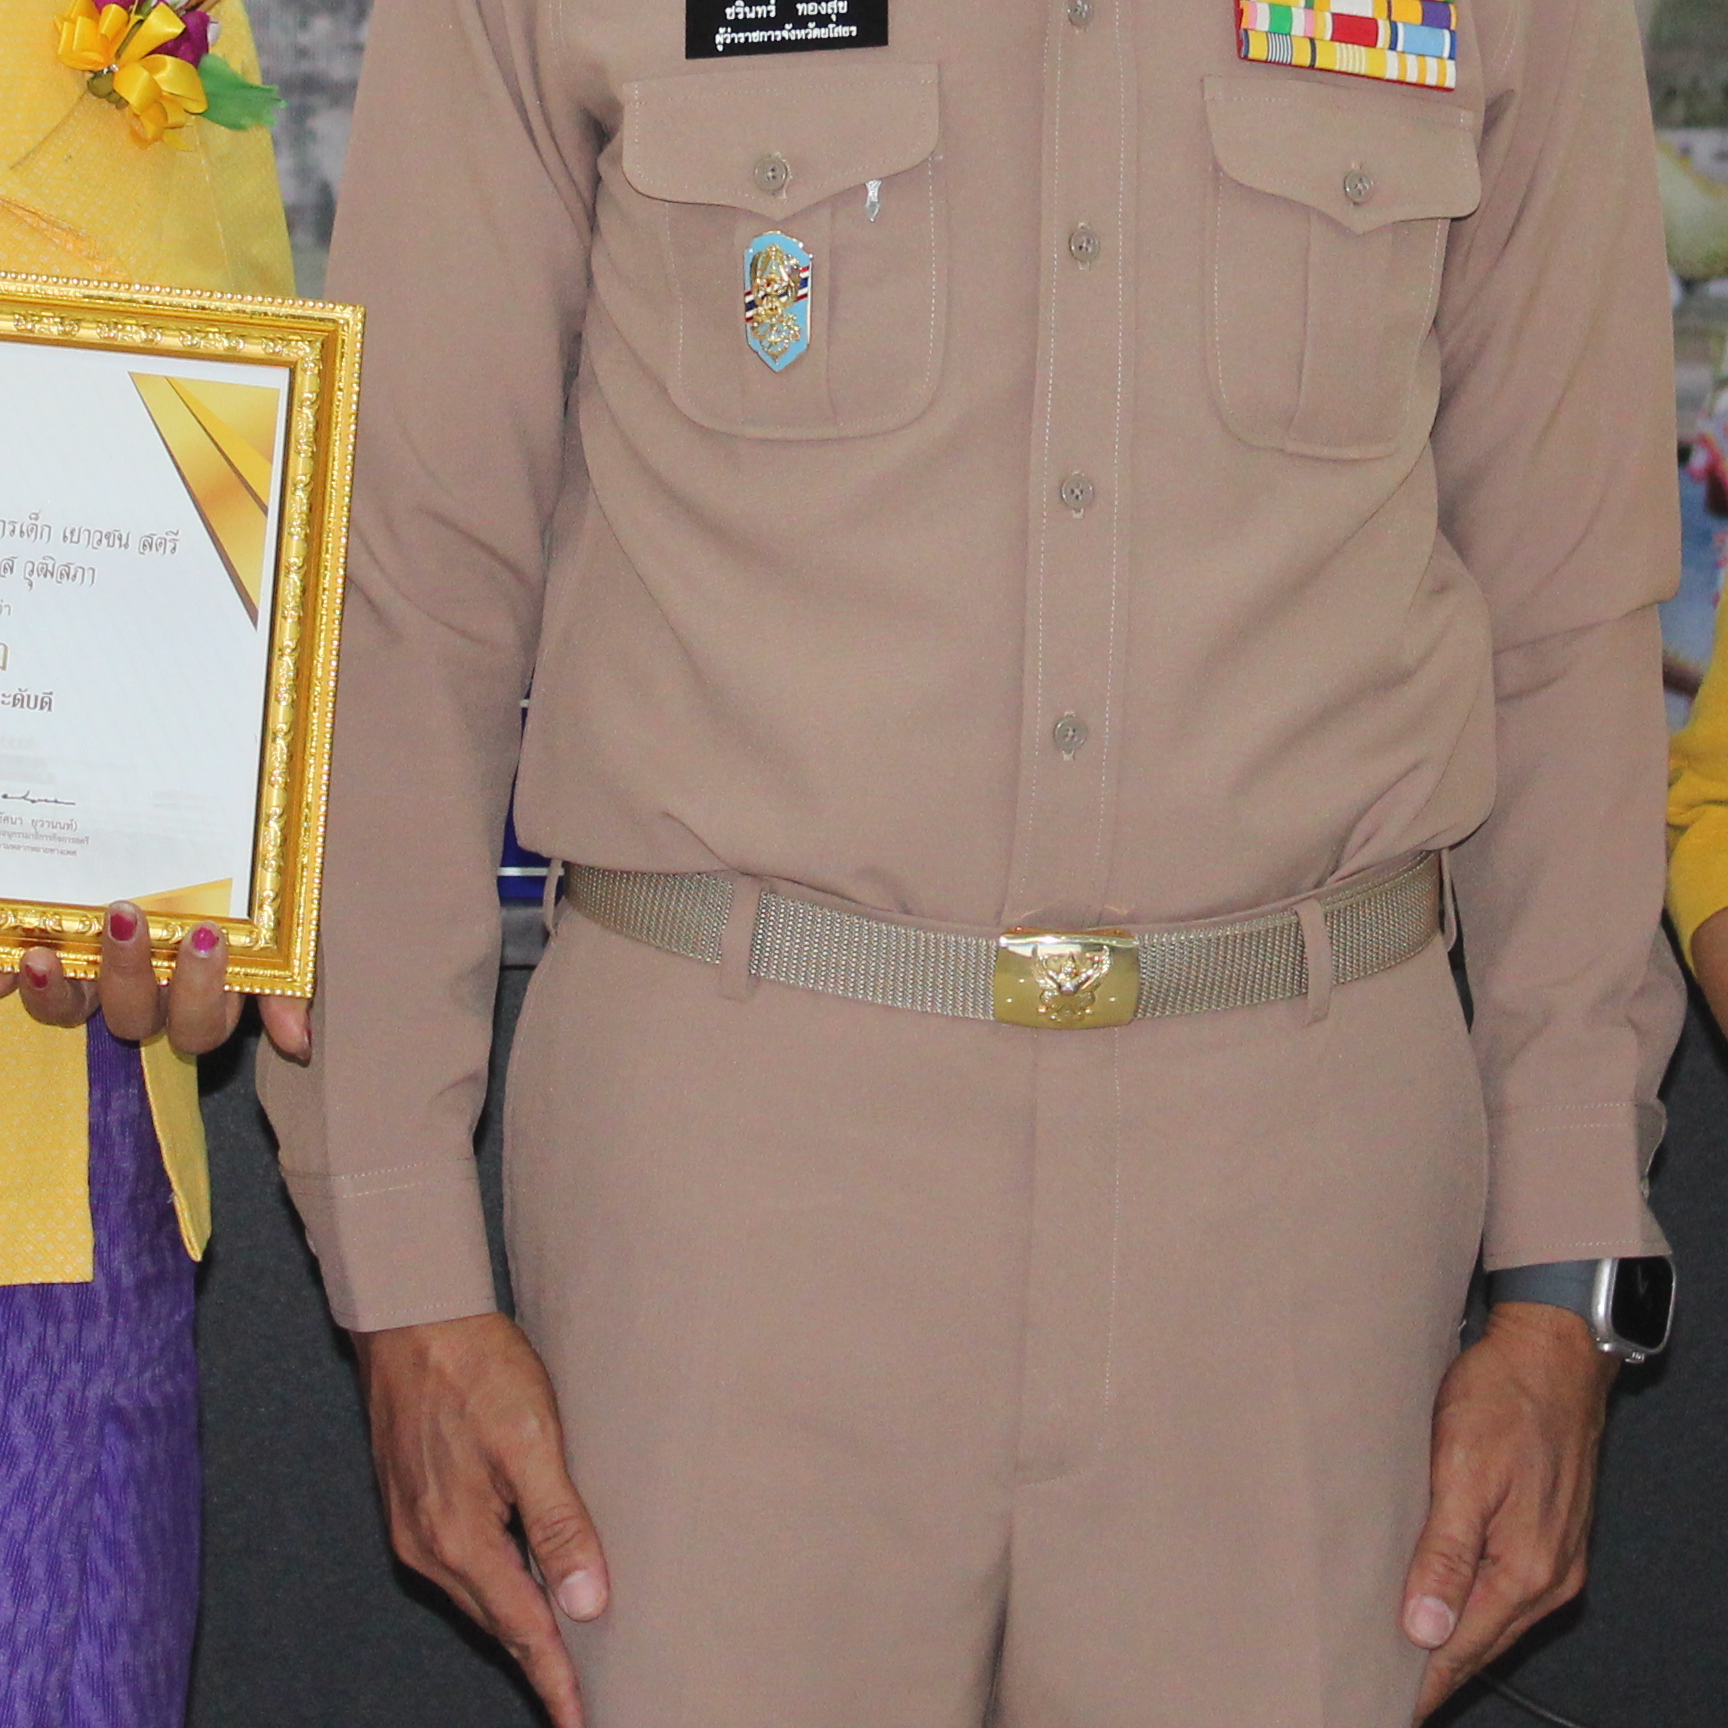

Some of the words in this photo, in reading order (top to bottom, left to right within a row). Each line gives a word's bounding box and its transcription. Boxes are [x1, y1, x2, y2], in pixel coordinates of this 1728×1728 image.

[714, 22, 858, 52] ผู้ว่าราชการจังหวัดยโสธร
[62, 525, 131, 549] เยาวชน
[138, 529, 181, 556] สตรี
[23, 556, 98, 591] วุฒิสภา
